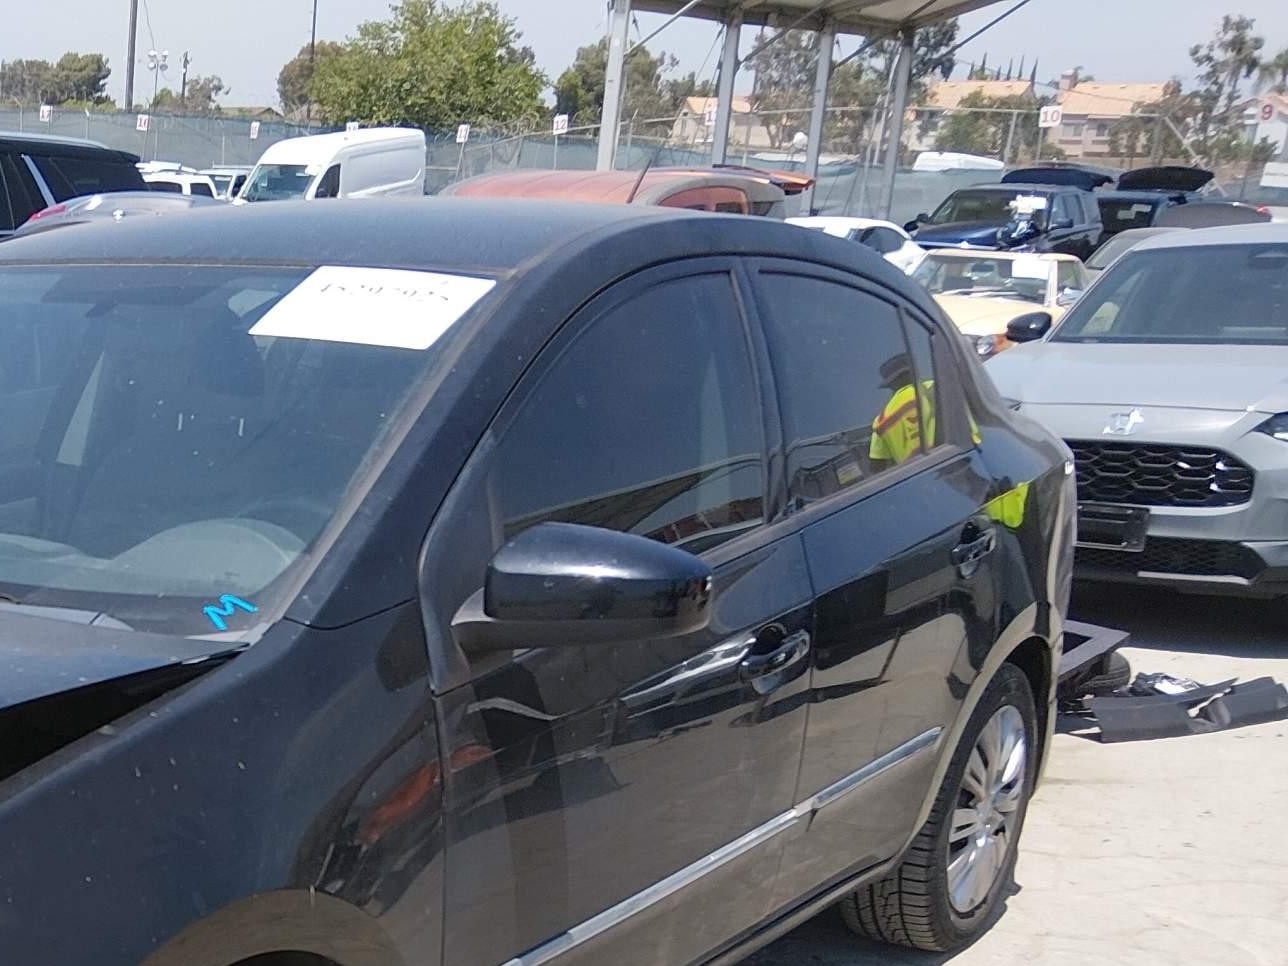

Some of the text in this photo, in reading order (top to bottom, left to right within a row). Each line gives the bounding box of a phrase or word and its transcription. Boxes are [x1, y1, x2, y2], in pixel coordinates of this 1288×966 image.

[1043, 110, 1060, 122] 10
[1263, 104, 1273, 120] 9
[555, 119, 566, 130] 12
[203, 593, 259, 632] M
